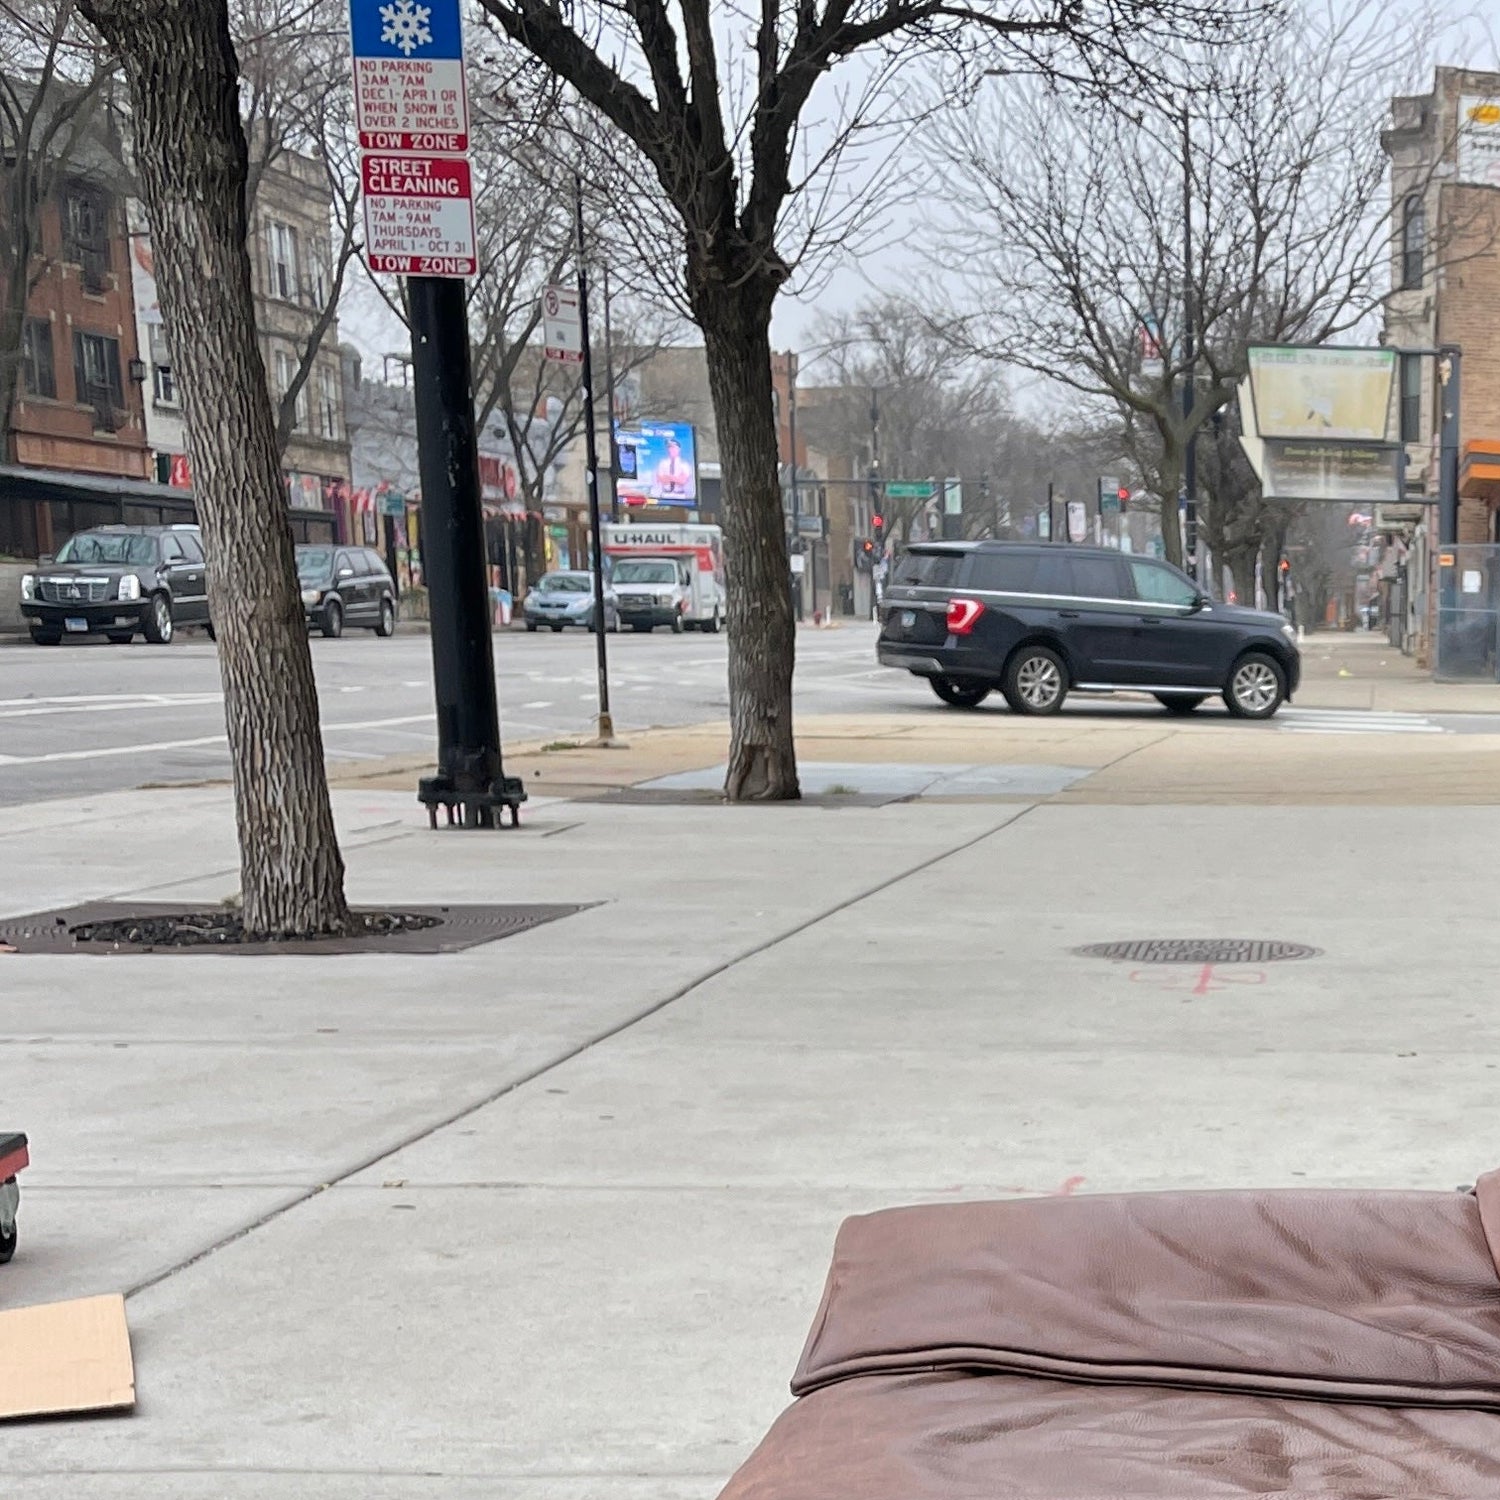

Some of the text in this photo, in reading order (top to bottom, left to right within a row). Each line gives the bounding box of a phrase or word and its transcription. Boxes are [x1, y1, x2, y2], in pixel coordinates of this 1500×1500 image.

[361, 60, 433, 73] NO PARKING
[362, 74, 389, 86] 3AM
[399, 75, 425, 86] 7AM
[362, 88, 385, 100] DEC
[389, 88, 393, 99] 1
[403, 89, 428, 101] APR
[432, 89, 436, 101] 1
[441, 90, 457, 102] OR
[363, 102, 455, 116] WHEN SNOW IS
[364, 115, 459, 129] OVER 2 INCHES
[365, 132, 460, 150] TOW ZONE
[368, 158, 432, 177] STREET
[368, 175, 459, 195] CLEANING
[370, 198, 442, 212] NO PARKING
[372, 211, 396, 222] 7AM
[406, 212, 432, 224] 9AM
[372, 225, 442, 239] THURSDAYS
[374, 239, 408, 251] APRIL
[411, 239, 416, 250] 1
[428, 240, 450, 253] OCT
[455, 242, 466, 253] 31
[374, 255, 411, 270] TOW
